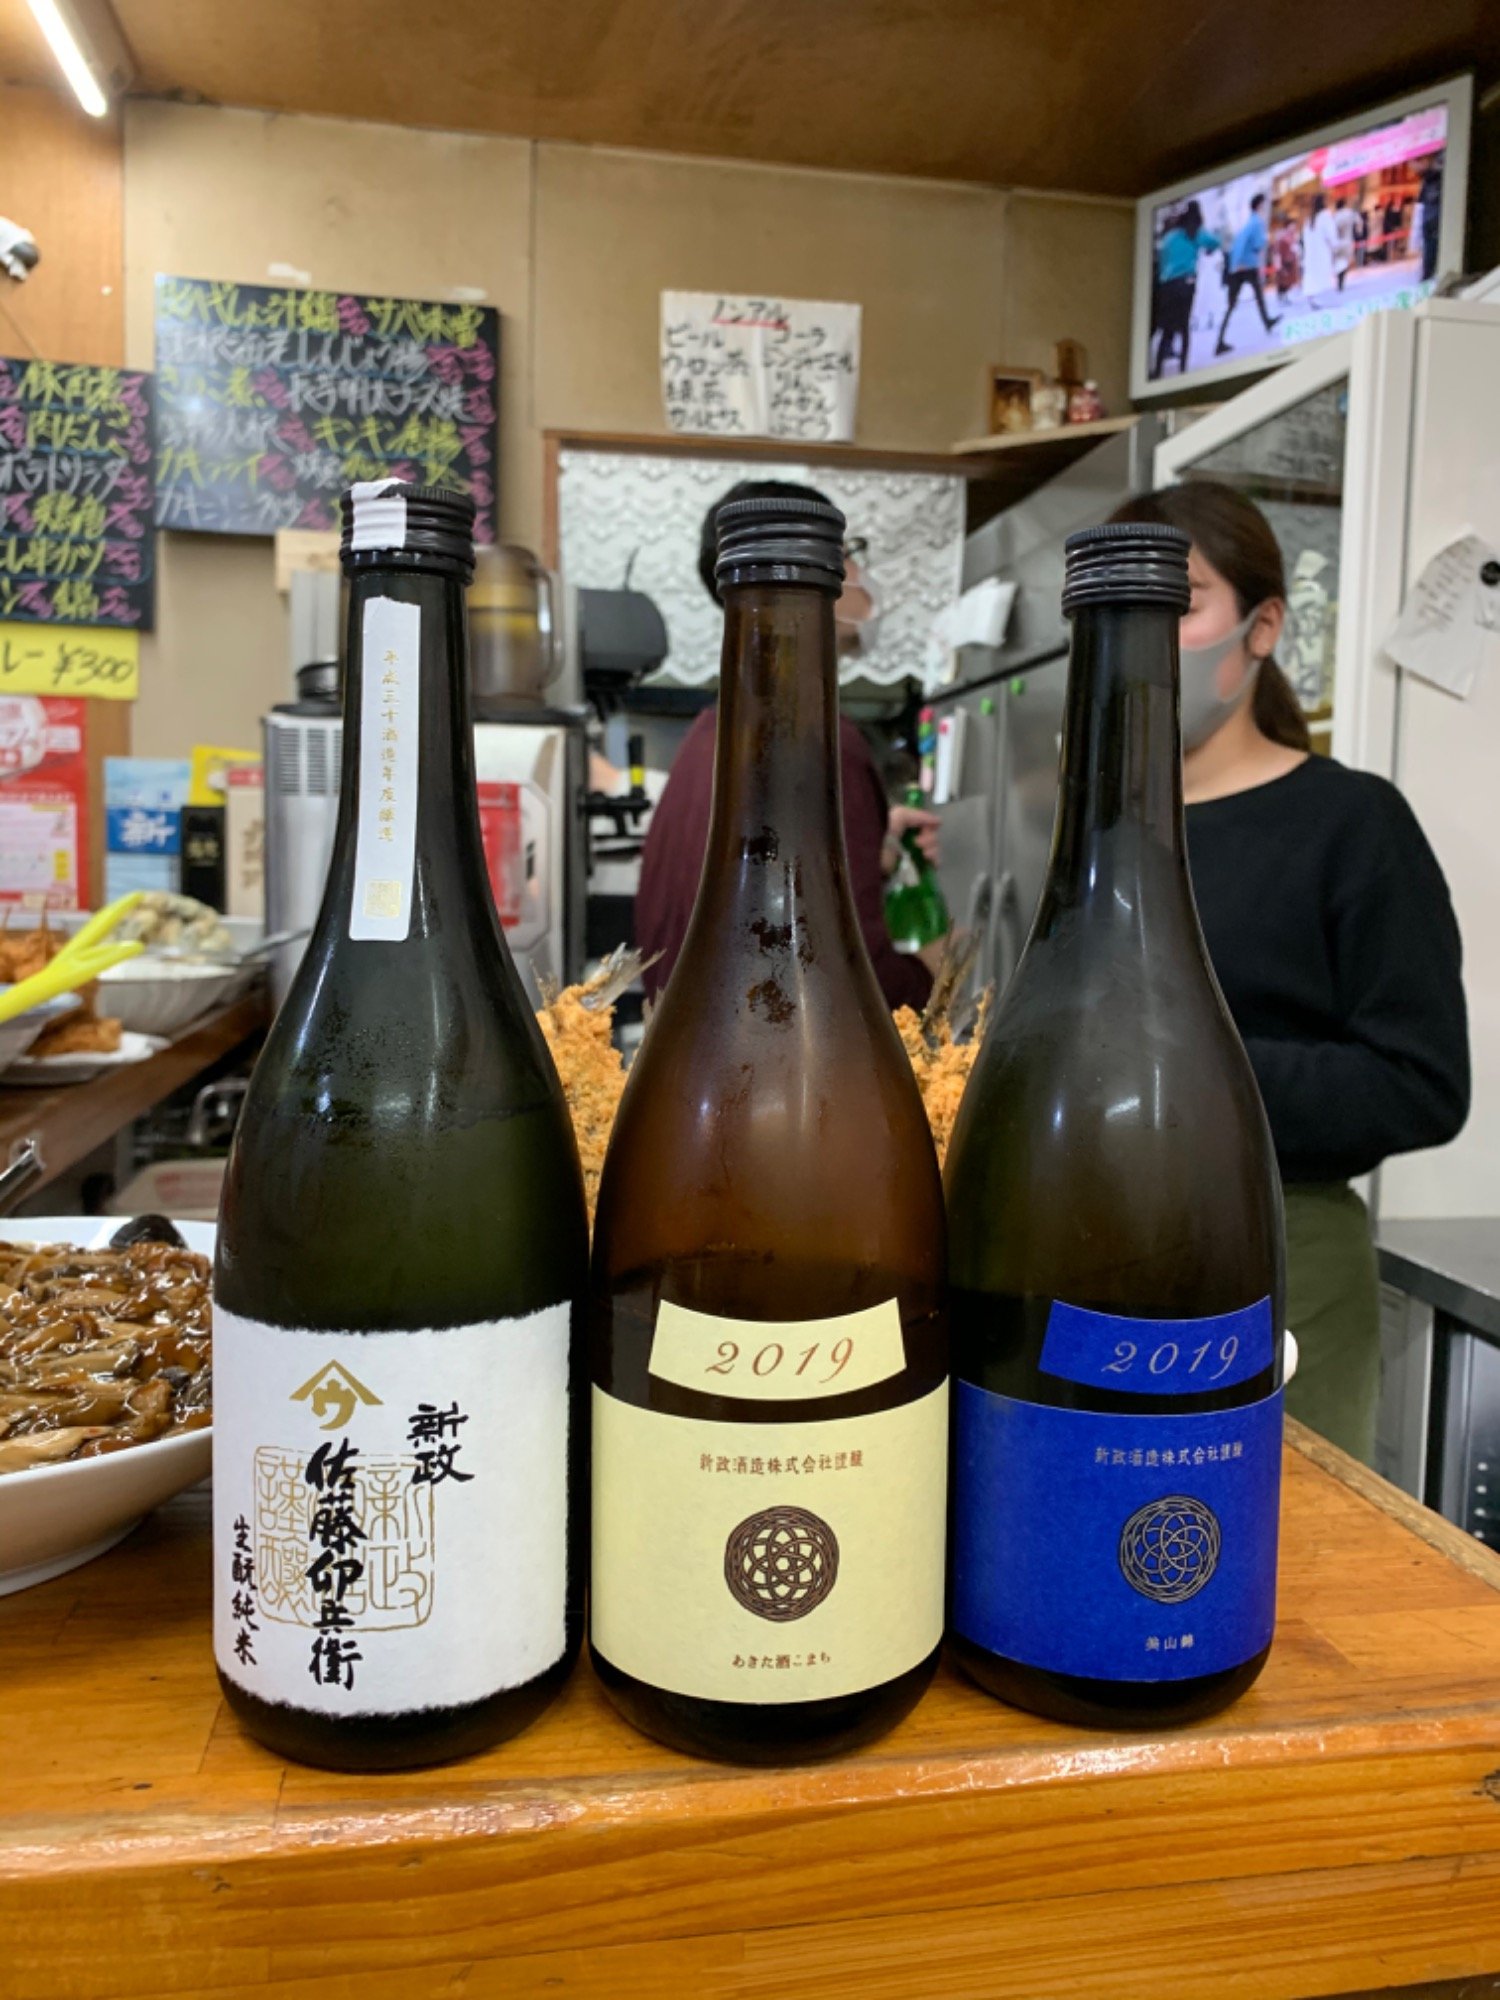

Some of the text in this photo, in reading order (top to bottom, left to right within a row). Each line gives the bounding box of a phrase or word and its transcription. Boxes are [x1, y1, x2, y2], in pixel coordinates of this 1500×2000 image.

[666, 322, 725, 348] ビール
[52, 640, 135, 686] ¥300
[703, 1336, 855, 1384] 2019
[1101, 1335, 1240, 1380] 2019
[406, 1400, 475, 1485] 新政
[731, 1650, 832, 1670] あきた酒こまち
